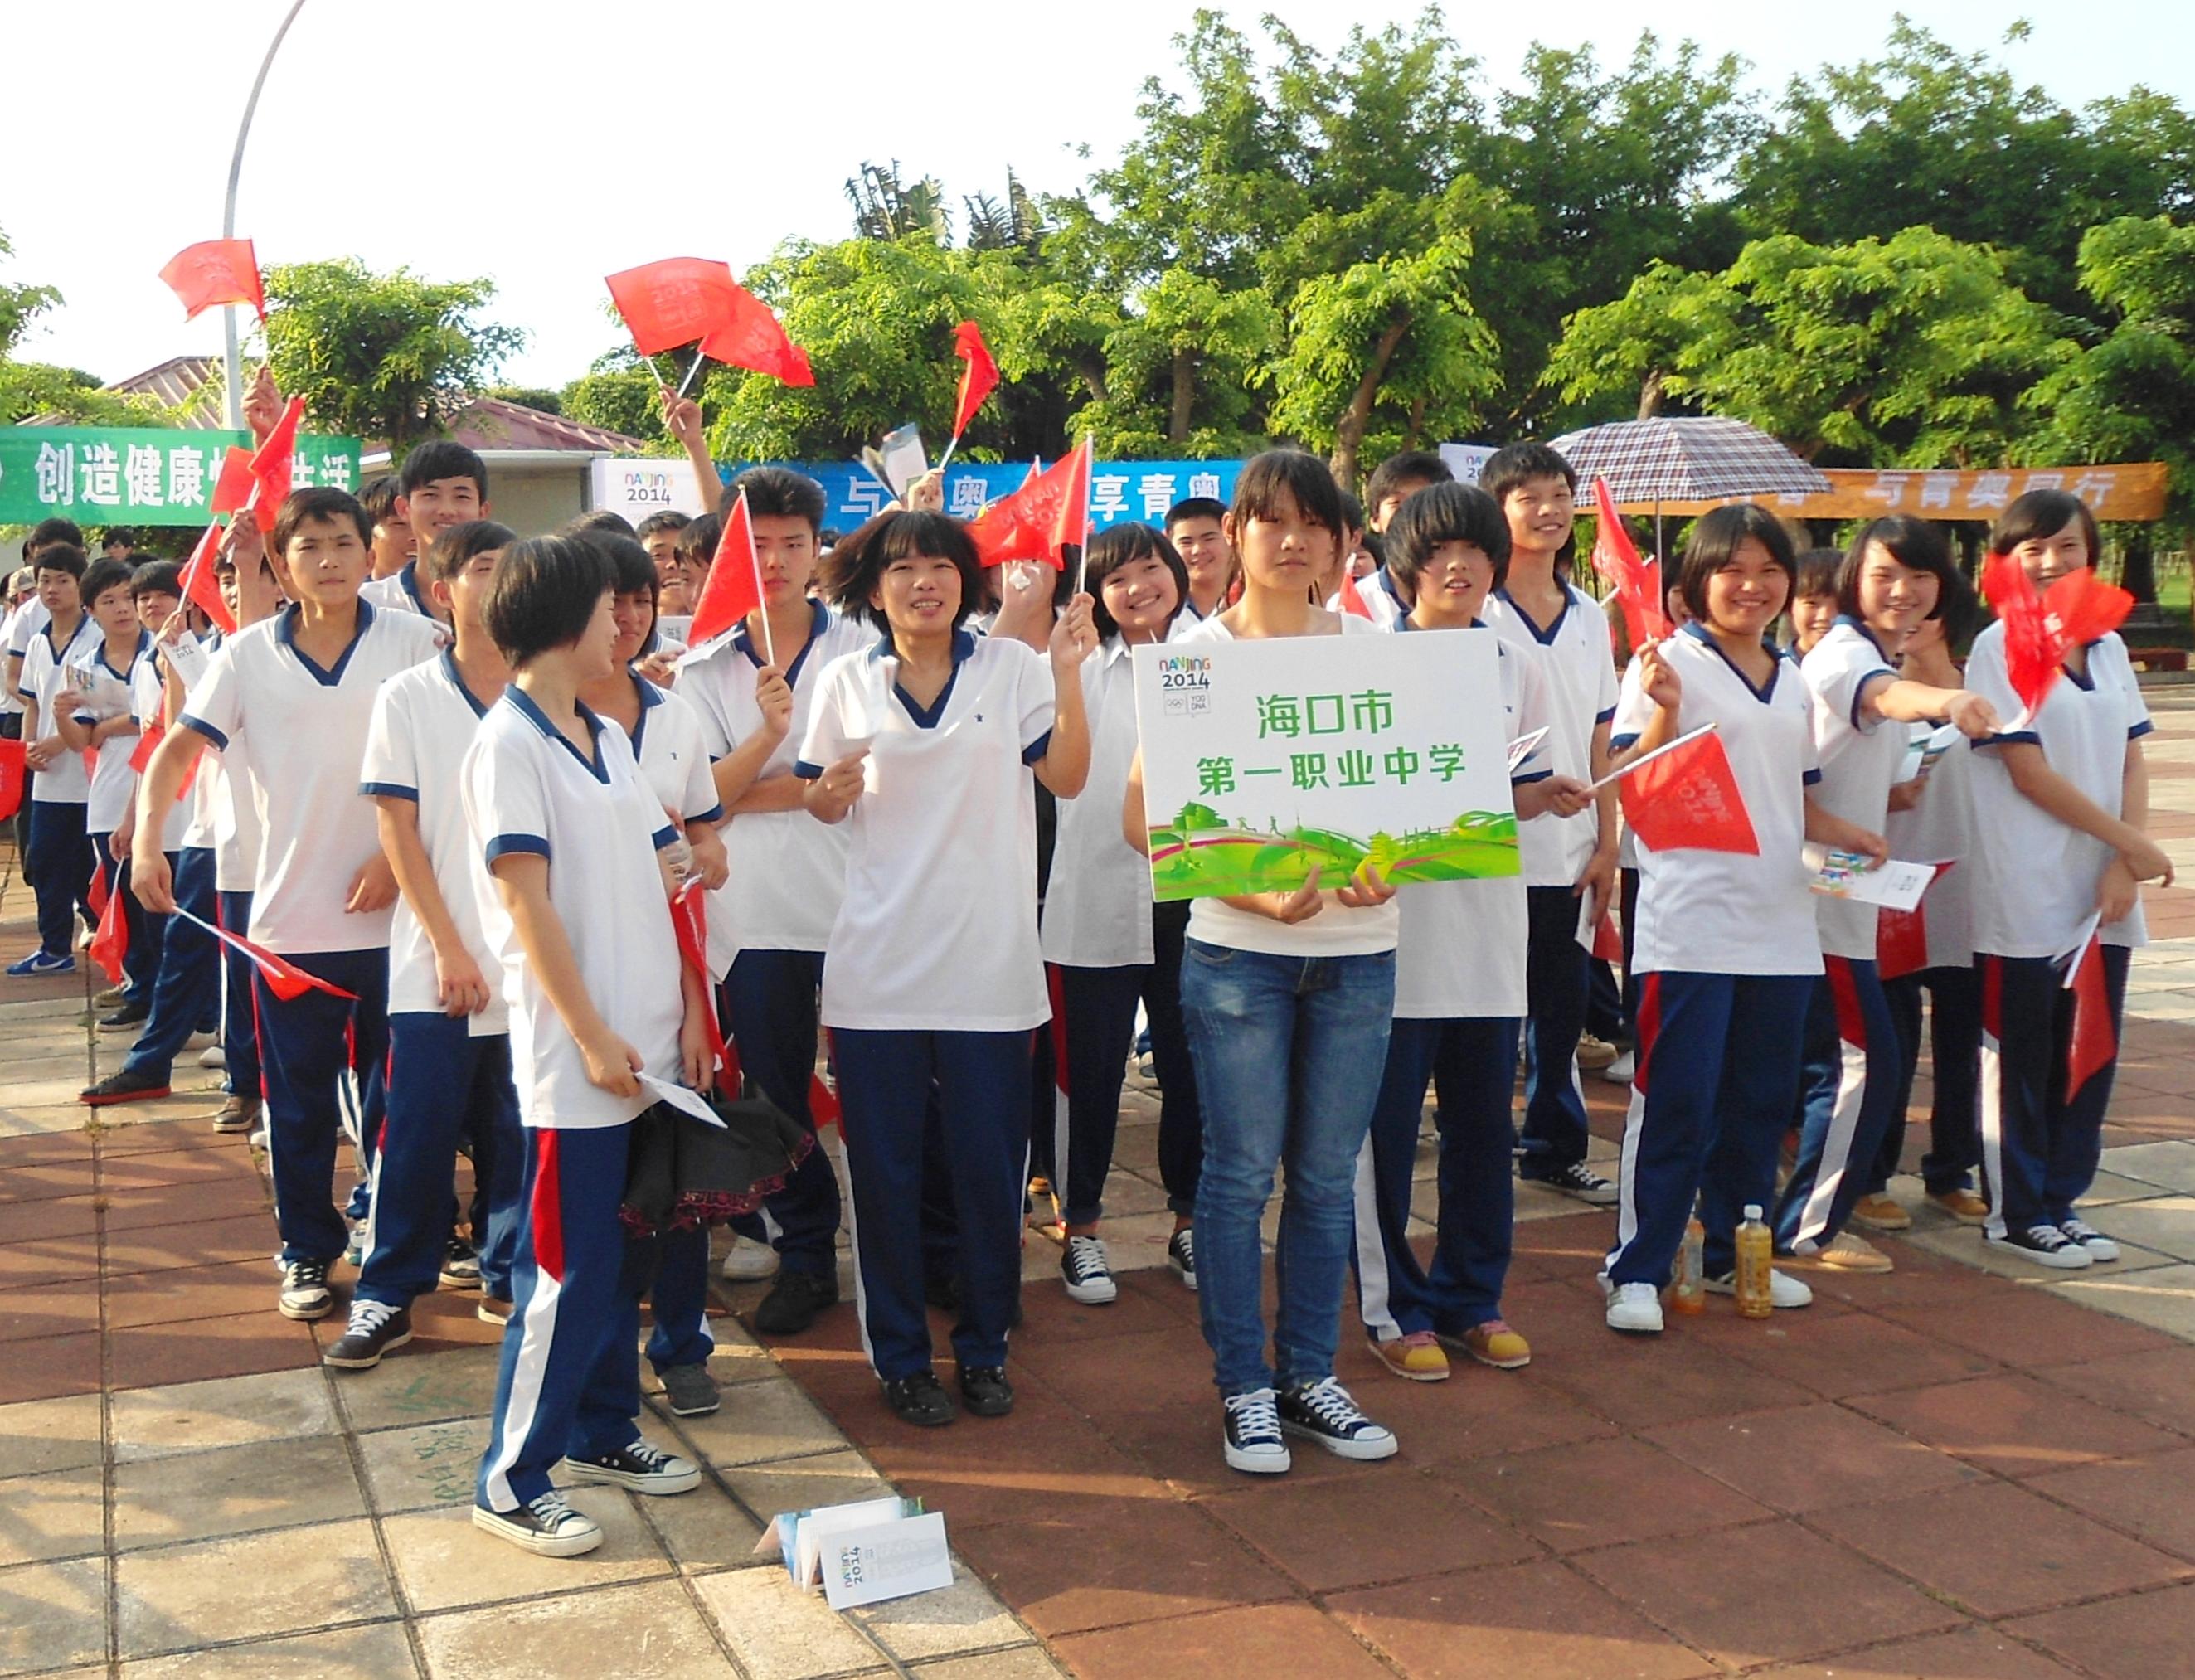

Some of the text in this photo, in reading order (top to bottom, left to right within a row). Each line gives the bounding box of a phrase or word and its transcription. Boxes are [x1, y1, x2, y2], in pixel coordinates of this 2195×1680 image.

[35, 441, 351, 507] 创造健康生活
[627, 488, 671, 505] 2014
[1162, 672, 1210, 689] 2014
[1255, 689, 1393, 740] 海口市
[1197, 743, 1466, 796] 第一职业中学
[849, 1546, 862, 1585] 2014
